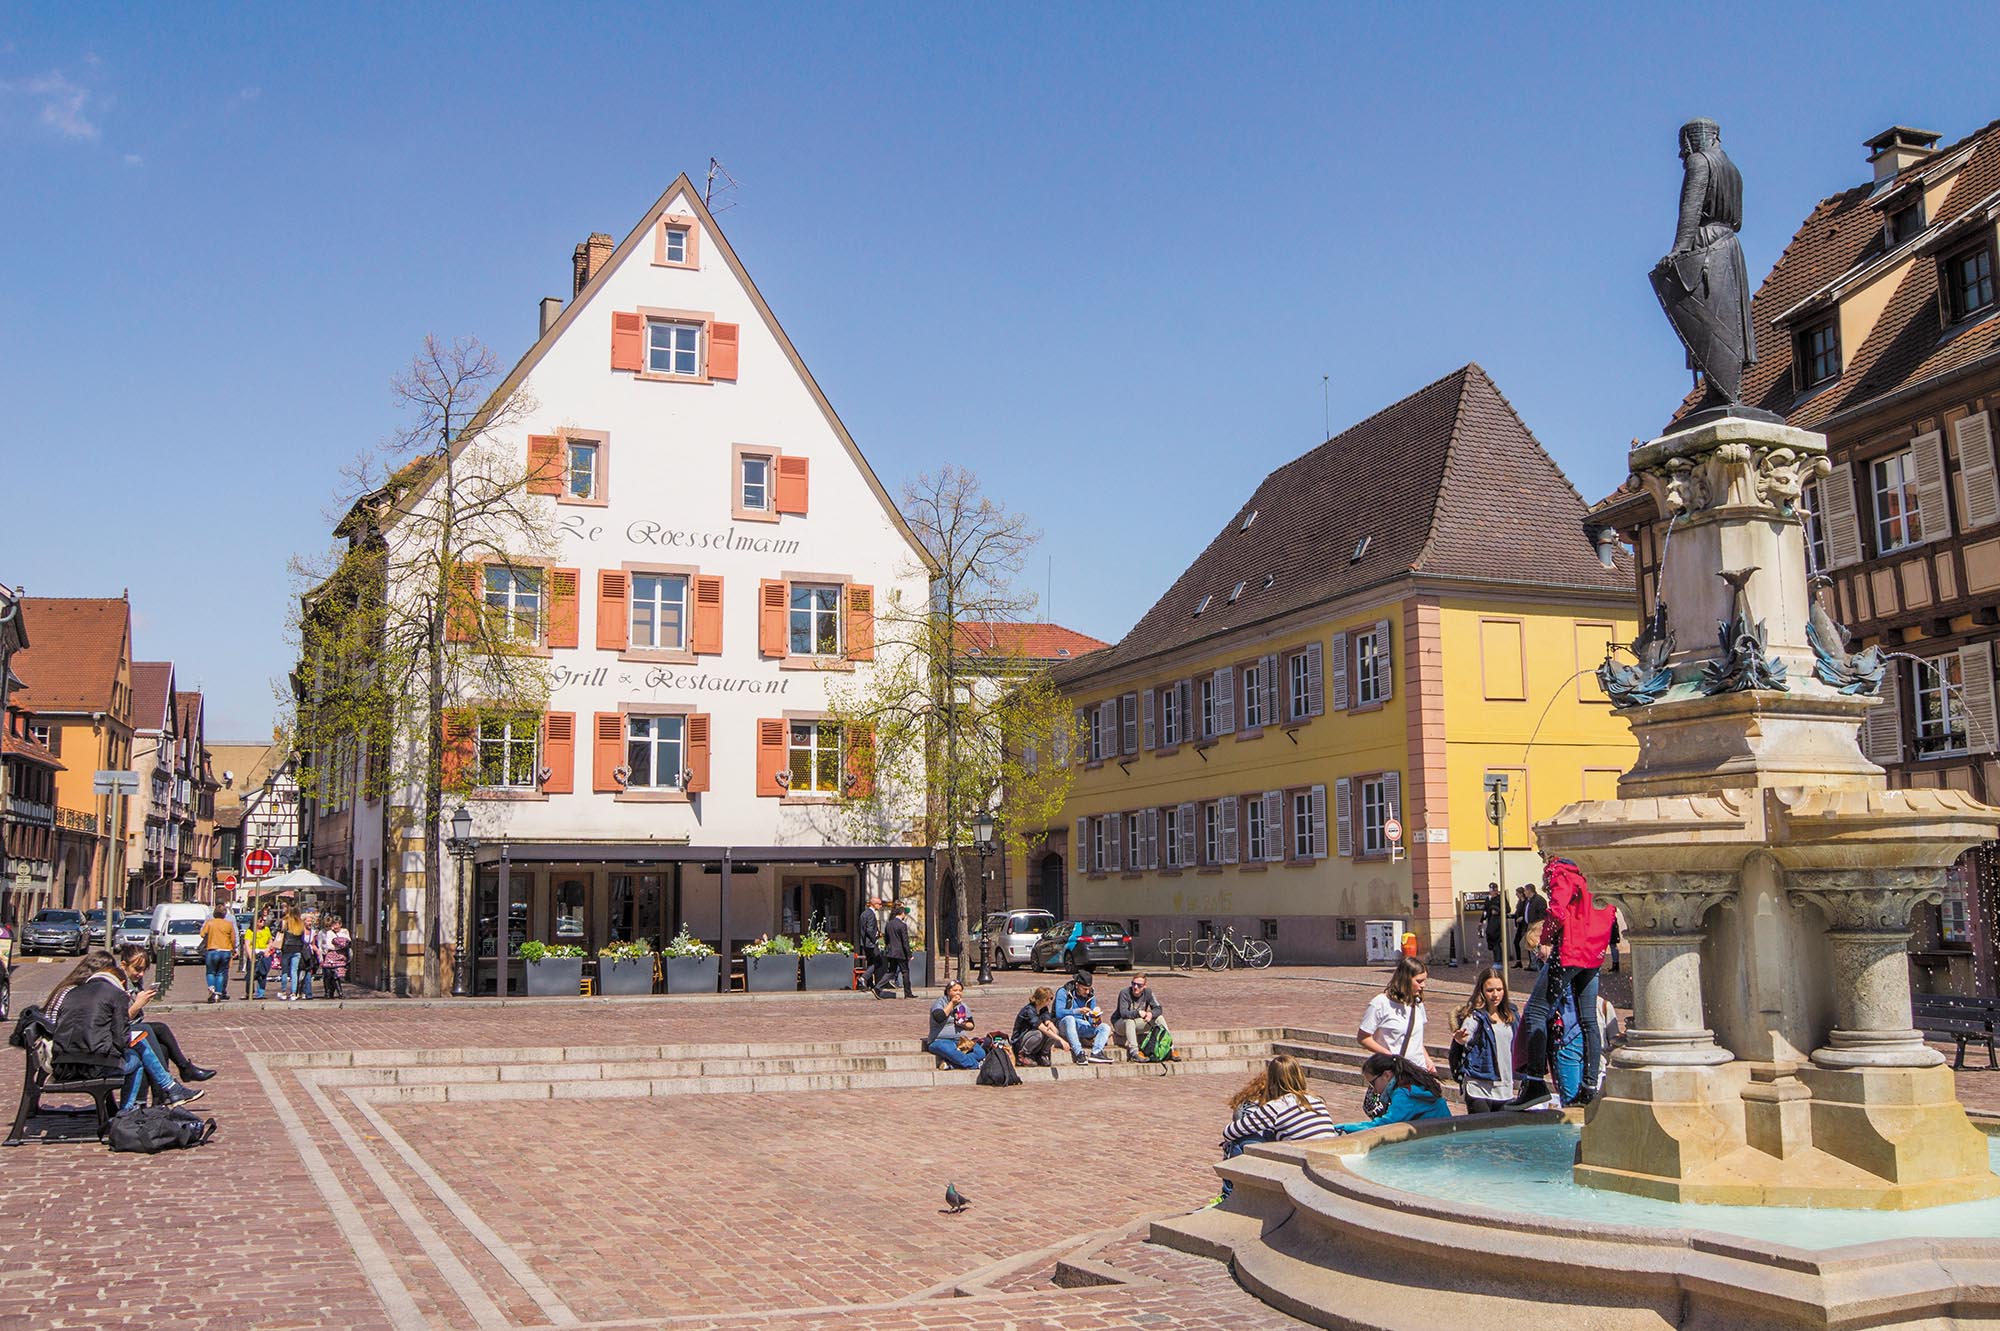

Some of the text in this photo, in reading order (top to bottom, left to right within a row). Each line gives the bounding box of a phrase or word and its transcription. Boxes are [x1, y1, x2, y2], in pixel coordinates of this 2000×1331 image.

[551, 515, 801, 555] Le Roesselmann
[548, 664, 790, 694] Grill & Restaurant
